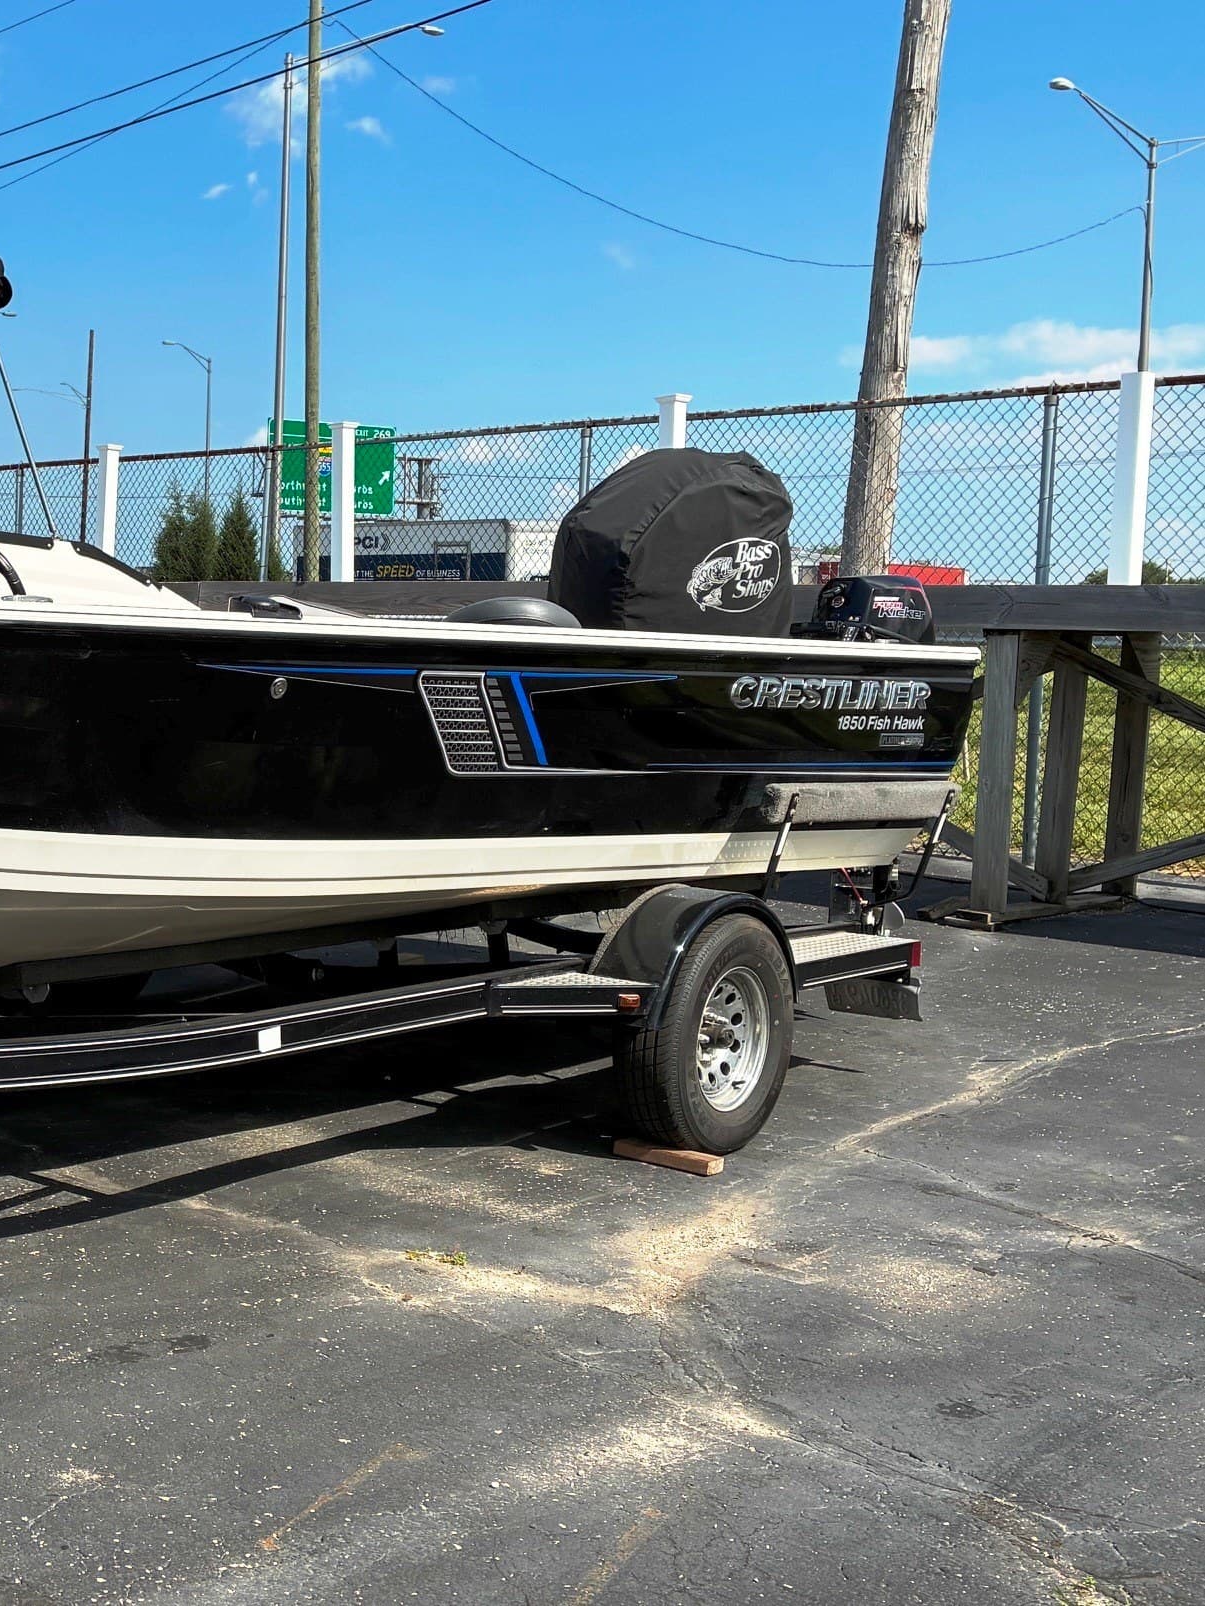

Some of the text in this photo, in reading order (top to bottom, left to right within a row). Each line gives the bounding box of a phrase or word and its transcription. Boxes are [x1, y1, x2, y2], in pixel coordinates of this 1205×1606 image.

[373, 429, 391, 438] 269
[735, 541, 773, 563] Bass
[376, 563, 415, 578] SPEED
[426, 569, 461, 578] BUSINESS
[734, 561, 764, 580] Pro
[732, 577, 775, 599] Shops
[878, 606, 926, 620] Kicker
[730, 675, 932, 710] CRESTLINER
[837, 714, 925, 730] 1850 Fish Hawk
